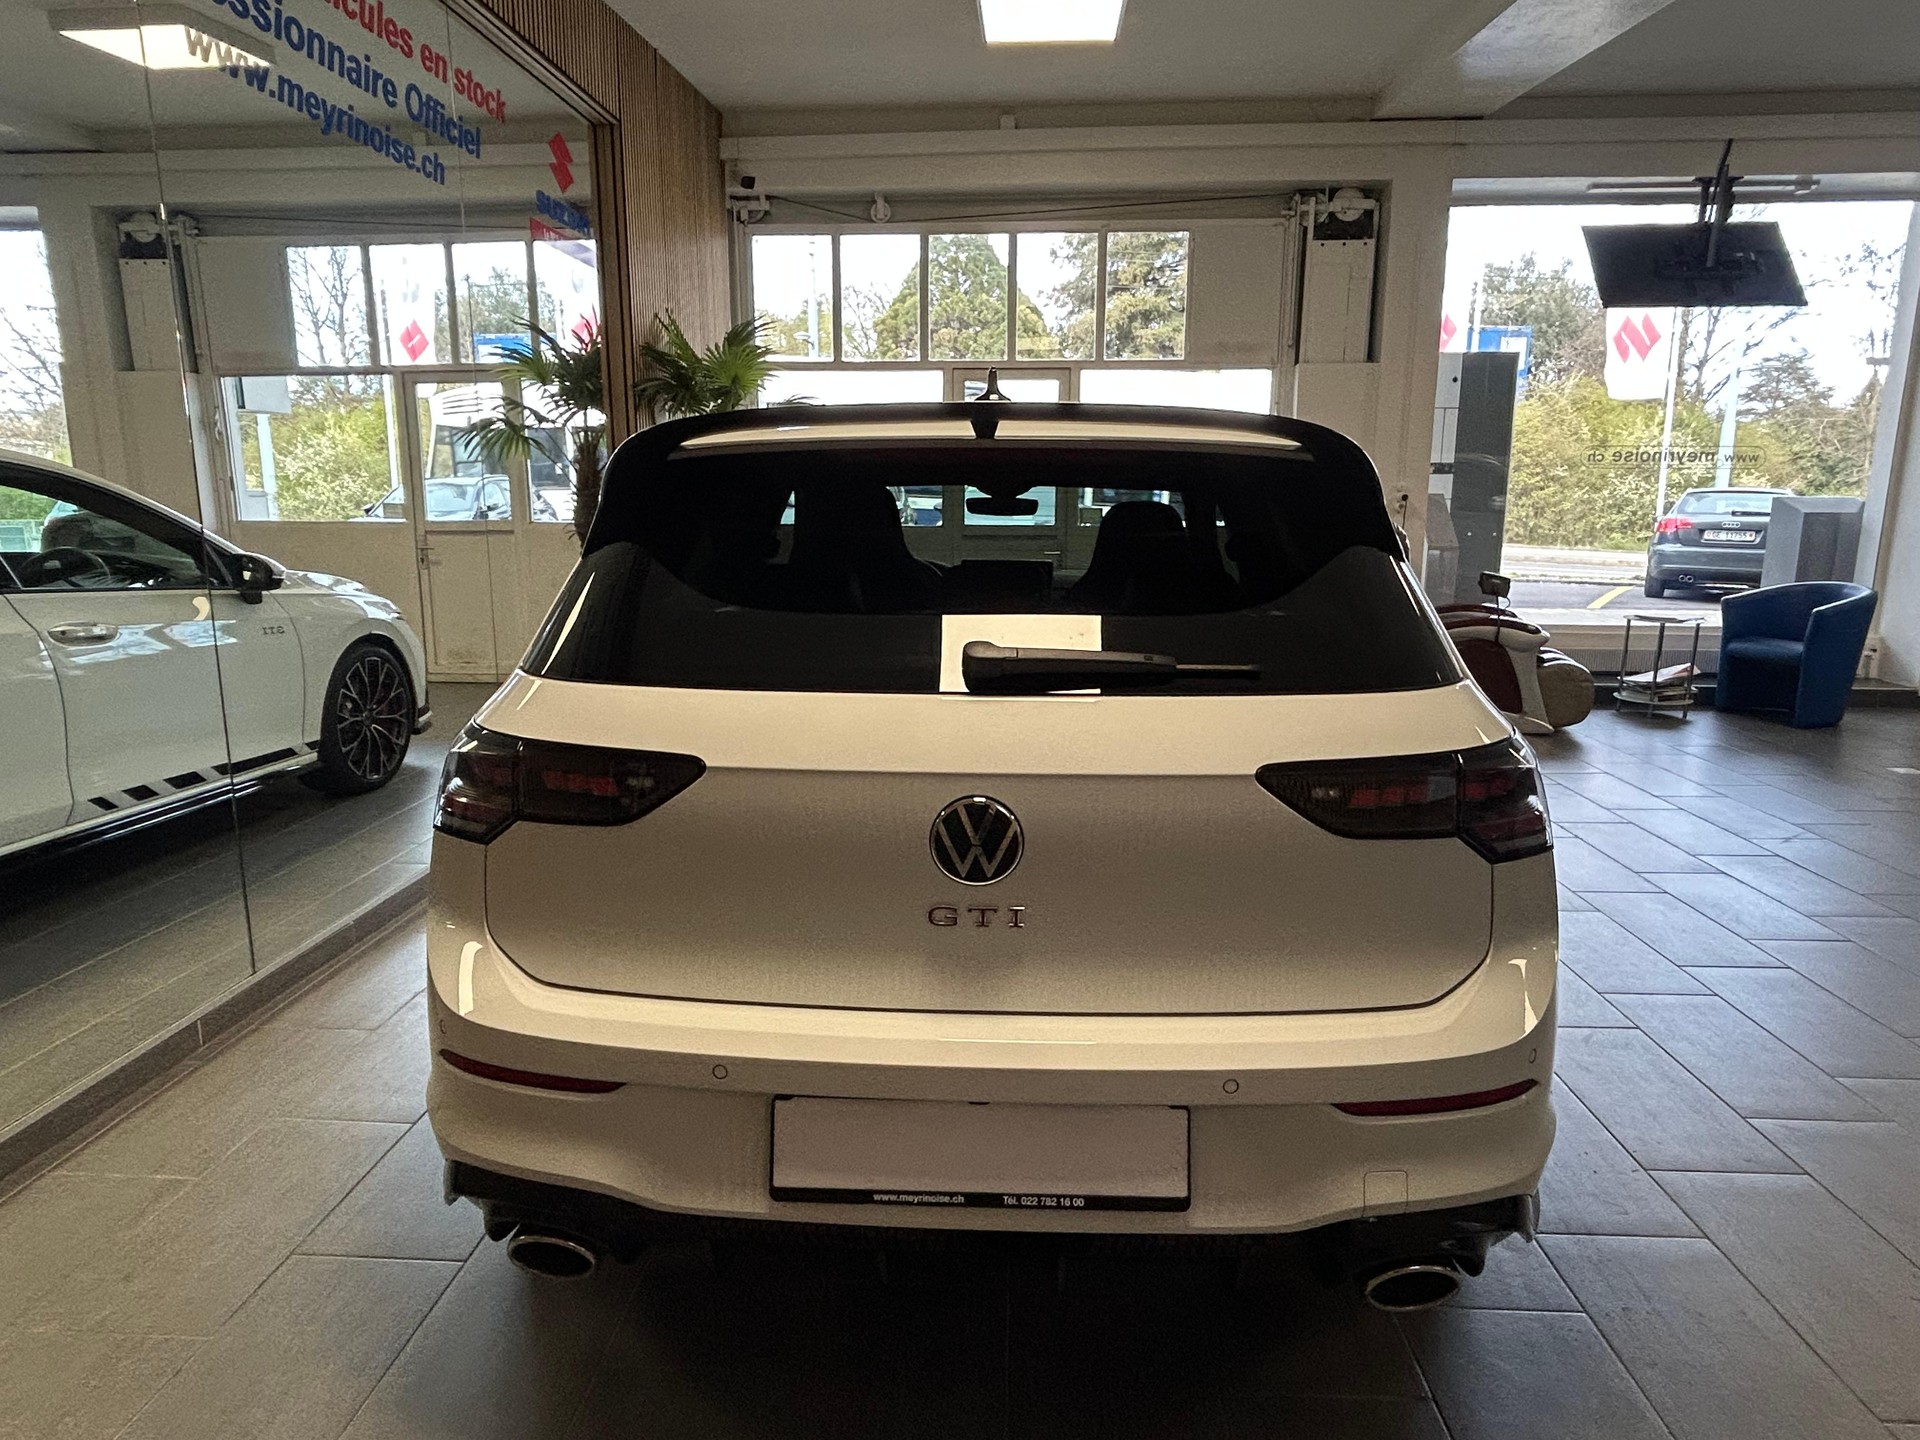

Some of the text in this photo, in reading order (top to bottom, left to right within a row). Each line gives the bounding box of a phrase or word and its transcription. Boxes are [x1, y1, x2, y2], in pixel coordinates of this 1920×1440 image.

[420, 43, 448, 84] en
[454, 67, 506, 124] stock
[404, 83, 481, 159] Officiel
[928, 905, 1025, 928] GTI
[1021, 1196, 1038, 1206] 022
[1040, 1197, 1057, 1207] 782
